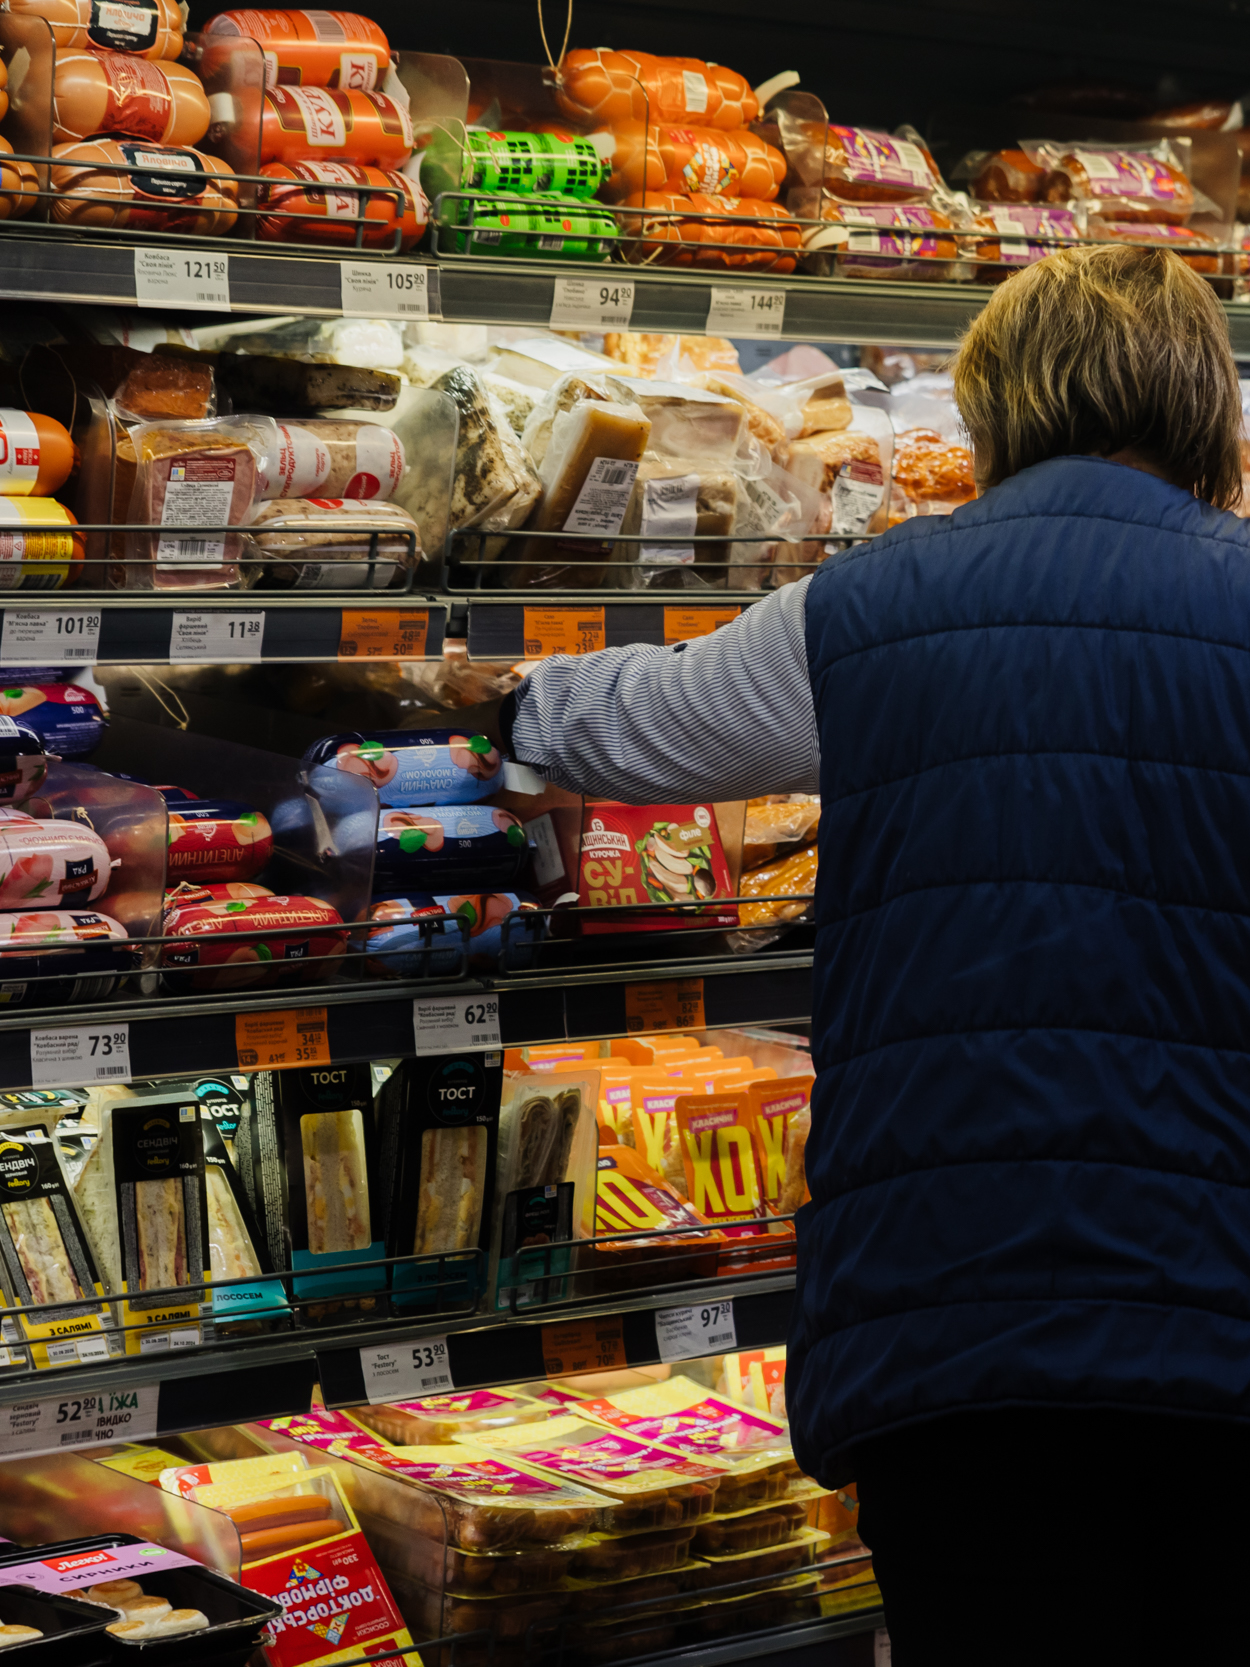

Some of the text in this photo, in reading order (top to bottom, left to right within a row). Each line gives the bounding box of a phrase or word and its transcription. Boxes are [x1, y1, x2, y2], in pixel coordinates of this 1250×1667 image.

[142, 154, 188, 167] Яловича
[144, 253, 170, 261] Ковбаса
[279, 448, 287, 476] ЗЕЛЬЦ
[589, 850, 622, 858] КУРОЧКА
[464, 1004, 487, 1025] 62
[88, 1035, 113, 1056] 73
[310, 1070, 347, 1085] ТОСТ
[438, 1086, 476, 1101] ТОСТ
[207, 1103, 240, 1118] ОСТ
[137, 1136, 178, 1149] СЕНДВІЧ
[0, 1157, 36, 1172] ЕНДВІЧ
[154, 1311, 191, 1322] САЛЯМІ
[49, 1322, 93, 1336] З САЛЯМІ
[412, 1347, 434, 1369] 53
[12, 1402, 39, 1412] Сендвіч
[108, 1392, 139, 1412] ЇЖА
[9, 1410, 41, 1420] зерновий
[56, 1401, 82, 1424] 52
[95, 1428, 114, 1441] ЧНО
[57, 1553, 109, 1571] Легко!
[59, 1561, 155, 1582] СИРНИКИ
[271, 1574, 350, 1608] ФІРМОВ
[356, 1621, 390, 1637] СОСИСКИ
